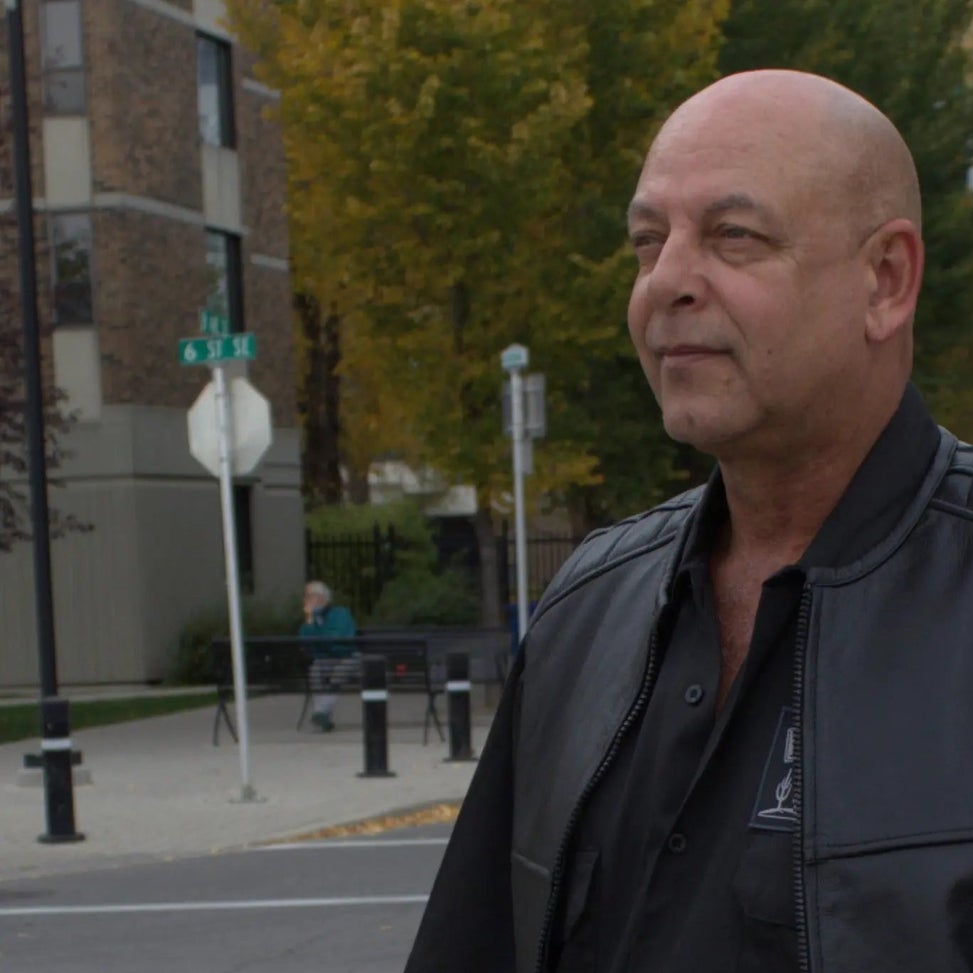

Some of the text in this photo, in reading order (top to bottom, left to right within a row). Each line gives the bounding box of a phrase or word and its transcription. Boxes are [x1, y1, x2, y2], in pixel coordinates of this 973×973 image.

[184, 336, 249, 361] 6 ST SE
